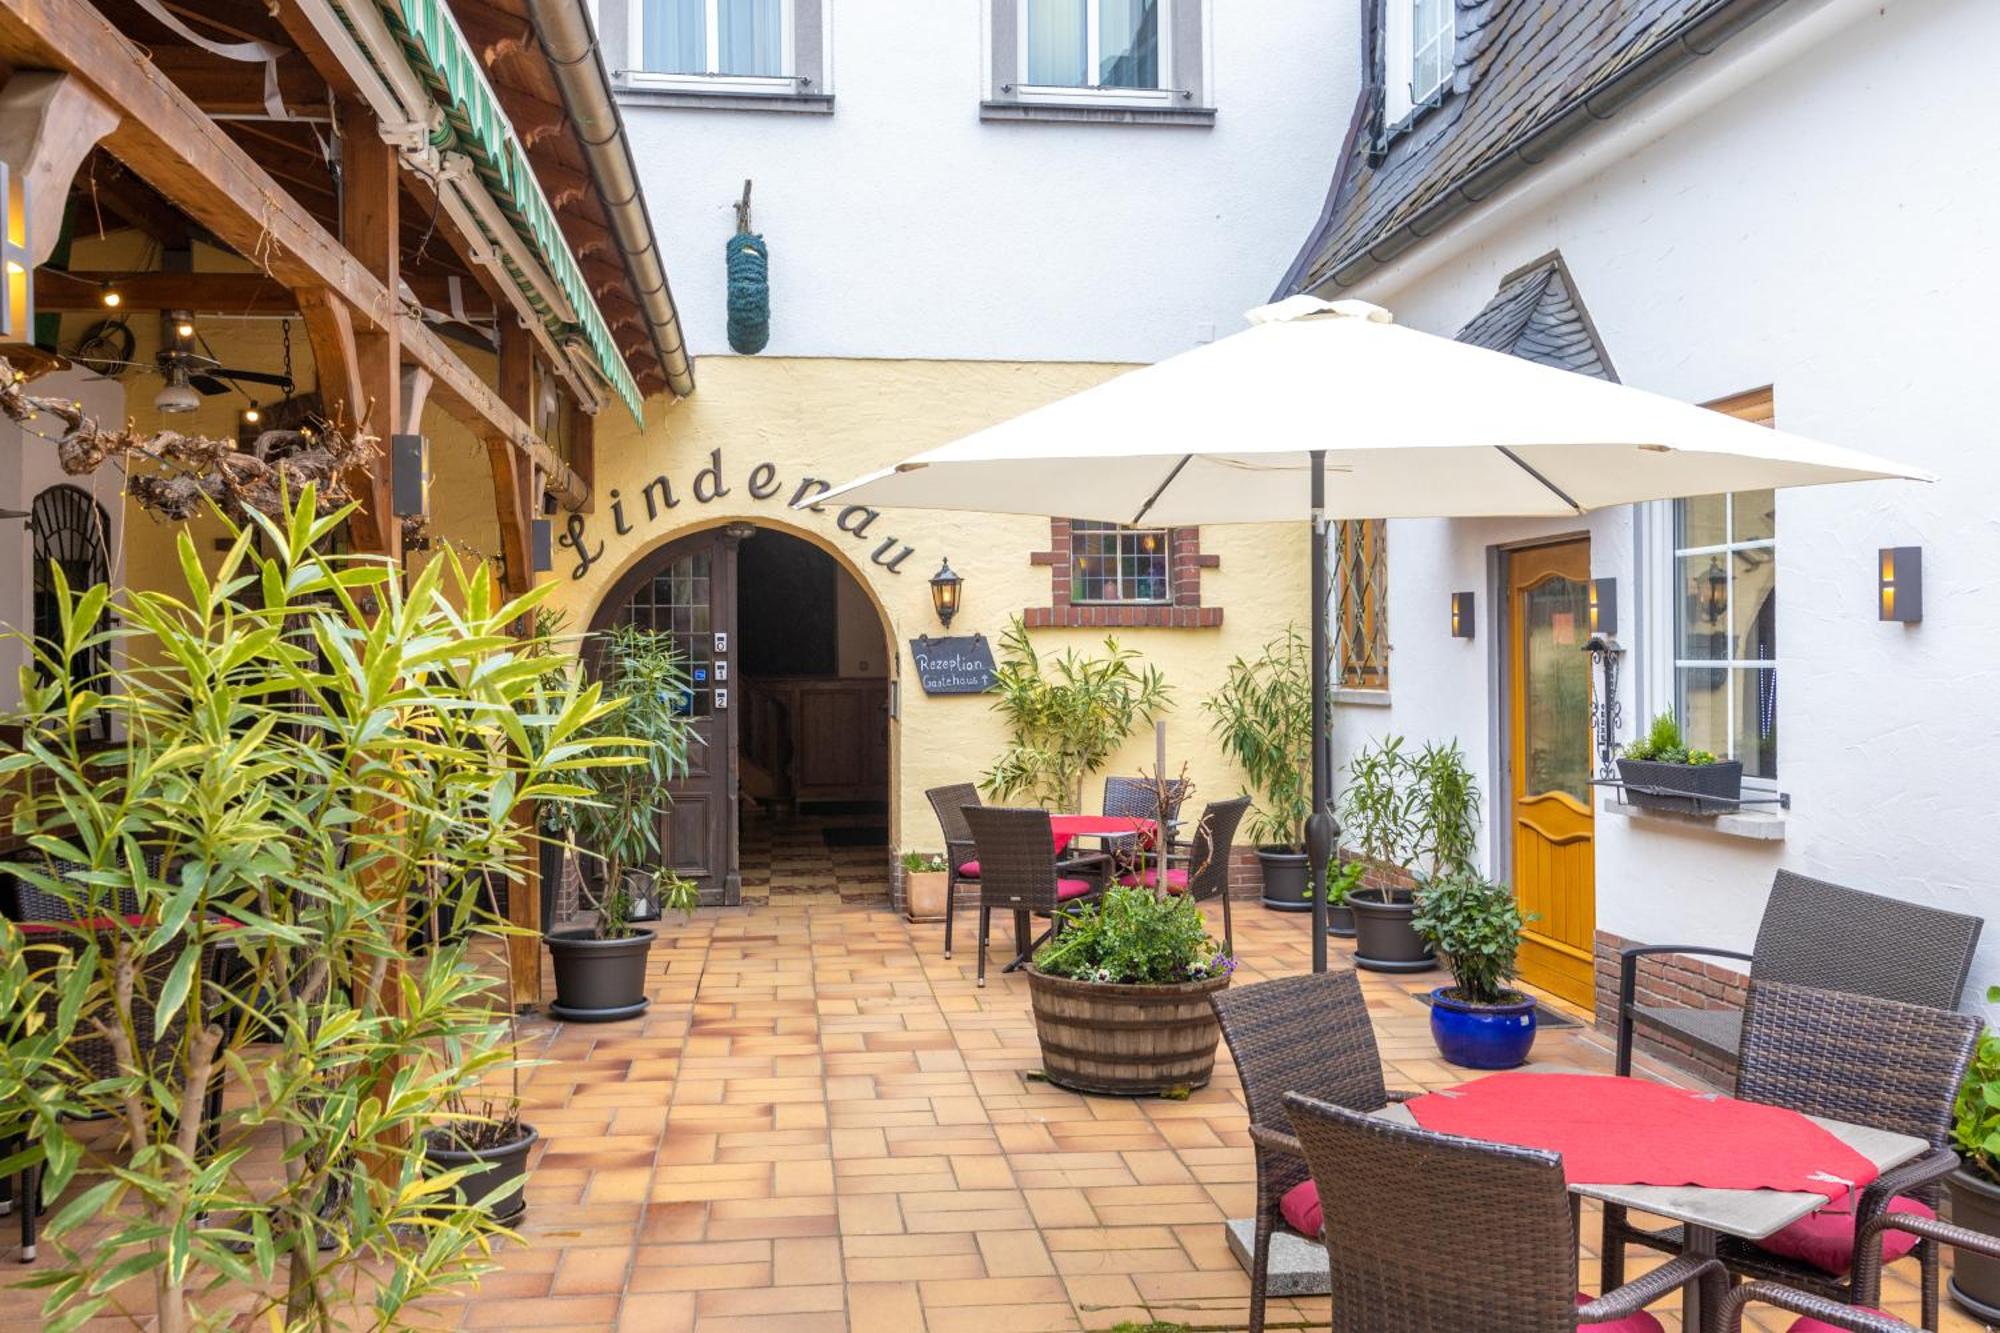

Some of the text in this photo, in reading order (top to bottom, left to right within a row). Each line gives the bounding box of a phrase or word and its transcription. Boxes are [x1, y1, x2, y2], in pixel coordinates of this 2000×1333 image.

[559, 447, 915, 581] Lindenau
[916, 653, 982, 672] Rezeption
[717, 698, 724, 707] 2
